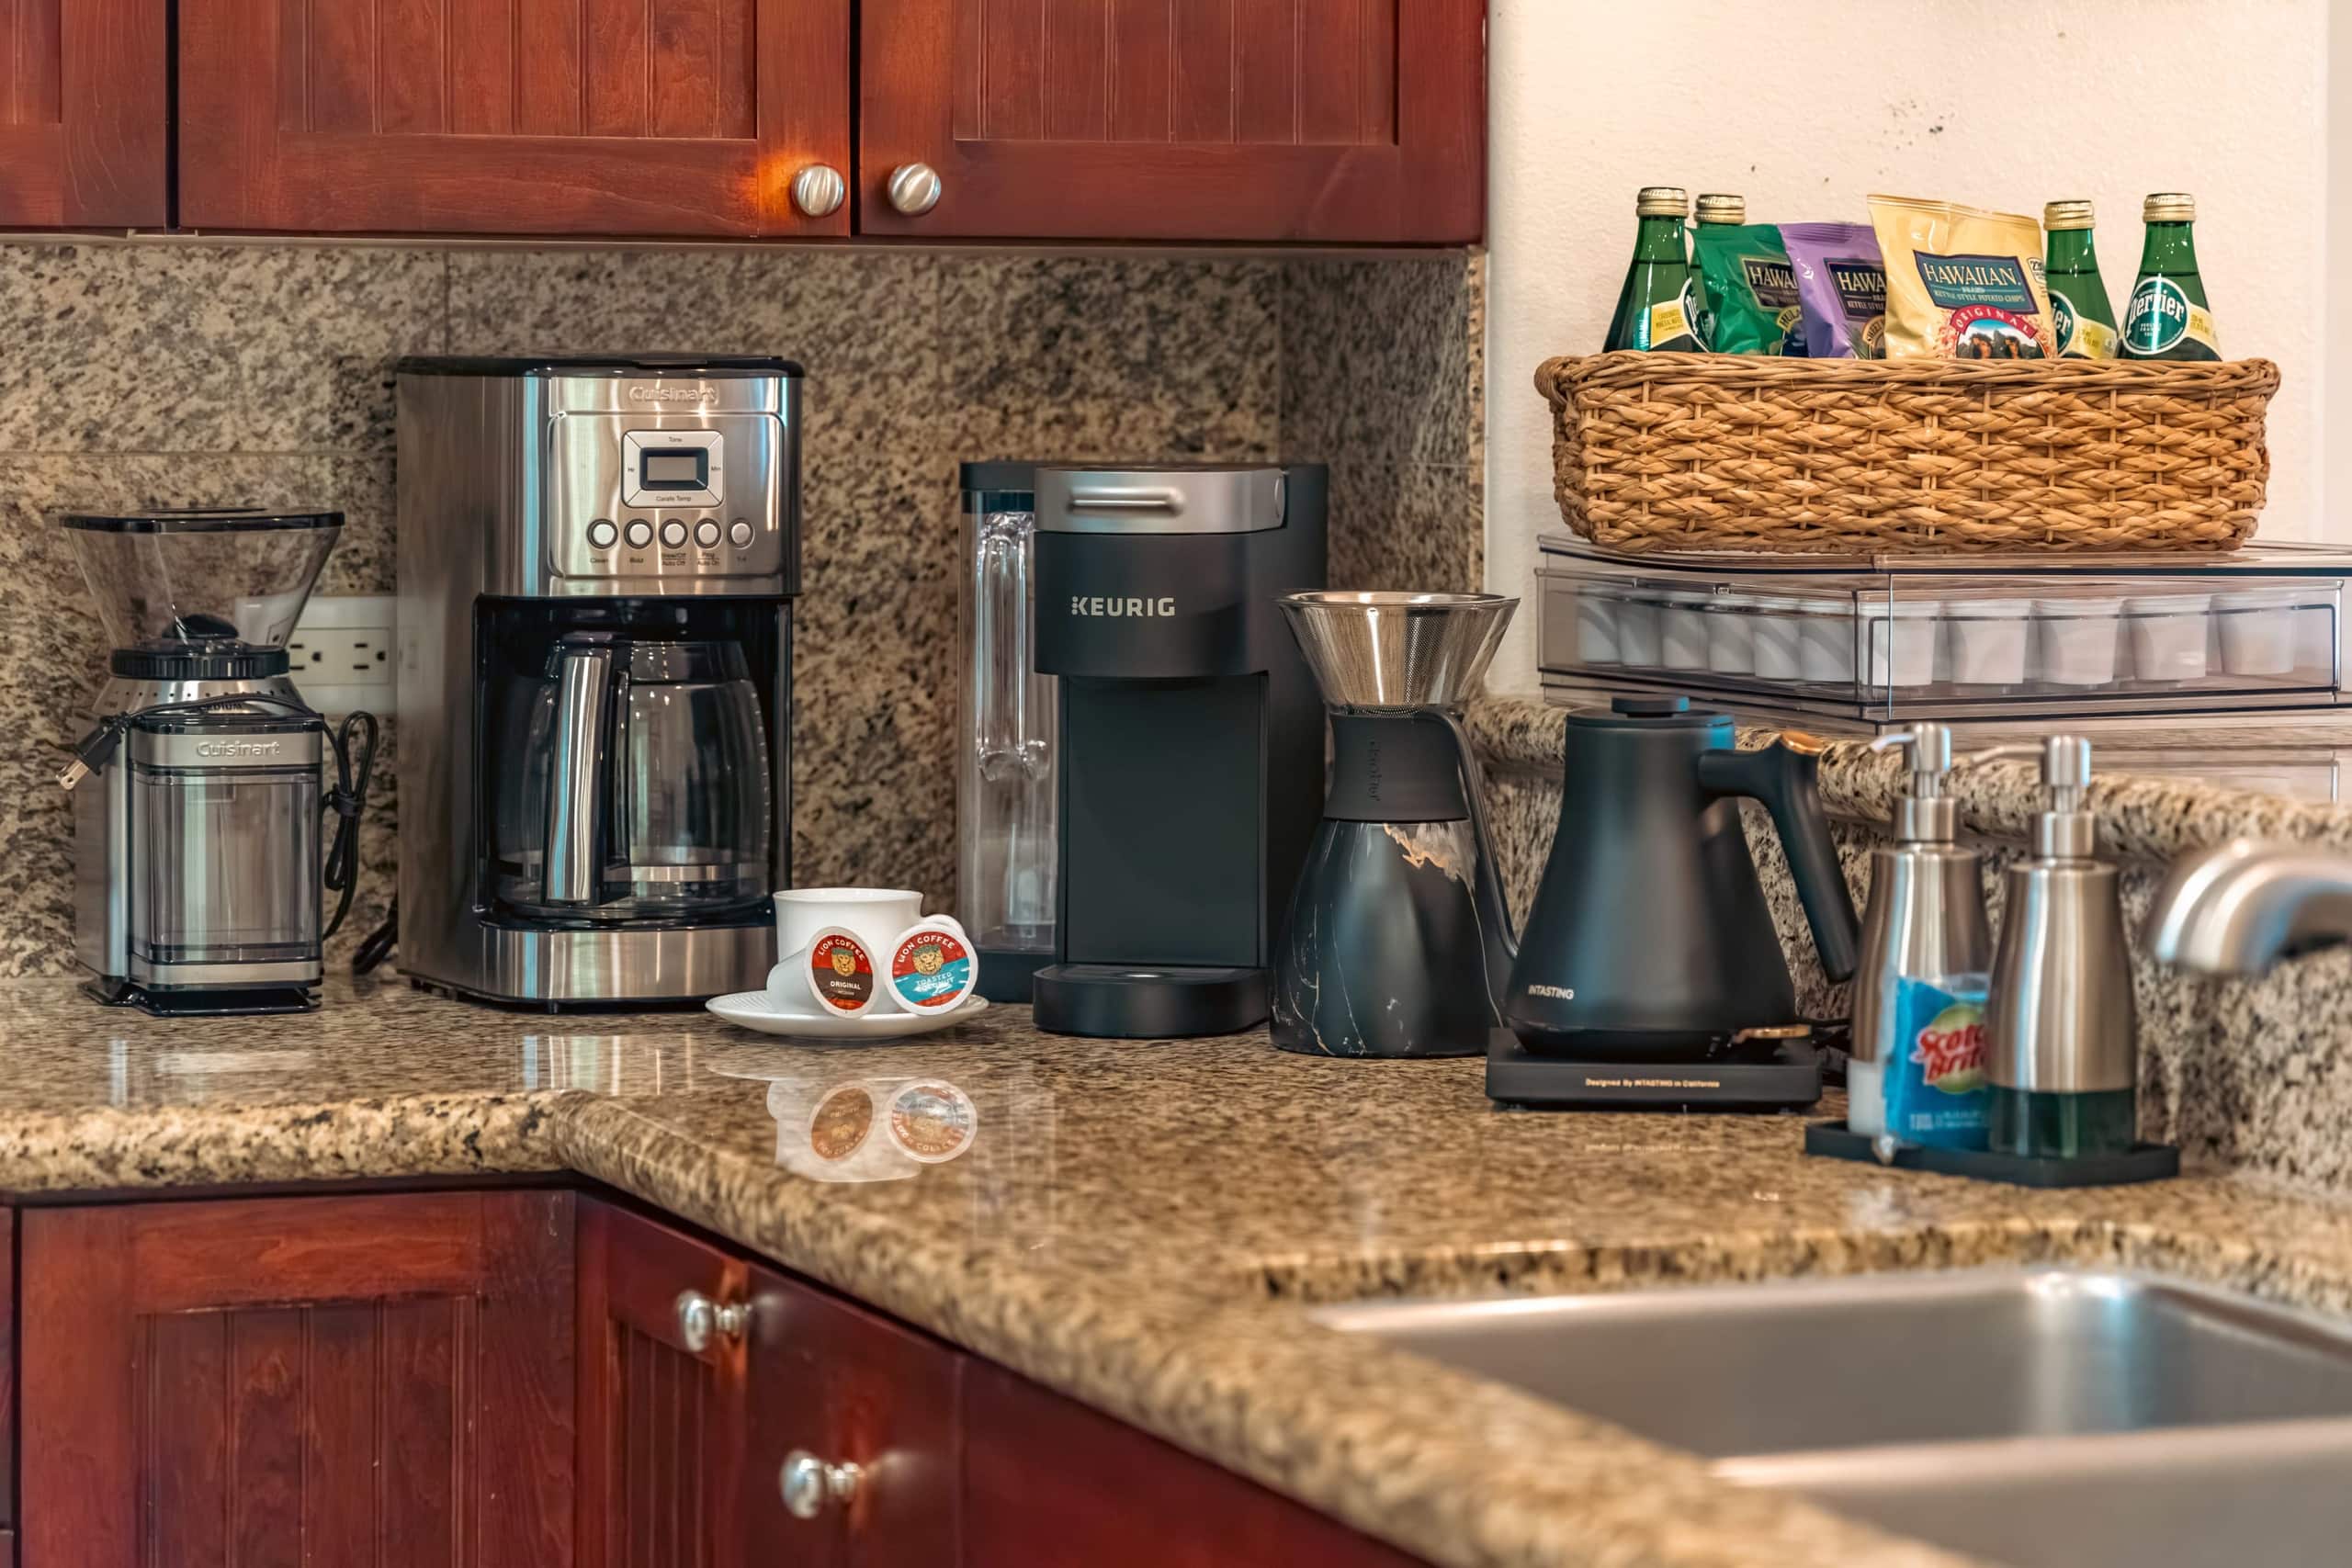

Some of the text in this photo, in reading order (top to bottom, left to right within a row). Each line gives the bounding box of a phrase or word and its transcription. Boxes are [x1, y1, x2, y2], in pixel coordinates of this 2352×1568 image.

[1923, 263, 2019, 286] HAWAIIAN
[1956, 307, 2029, 333] ORIGINAL
[629, 385, 718, 404] Cuisinart
[676, 495, 691, 503] Temp
[1071, 595, 1176, 617] KEURIG
[197, 739, 280, 758] Cuisinart
[818, 938, 865, 962] LION COFFEE
[898, 934, 956, 963] LION COFFEE
[830, 980, 862, 990] ORIGINAL
[1586, 1077, 1621, 1089] Designed
